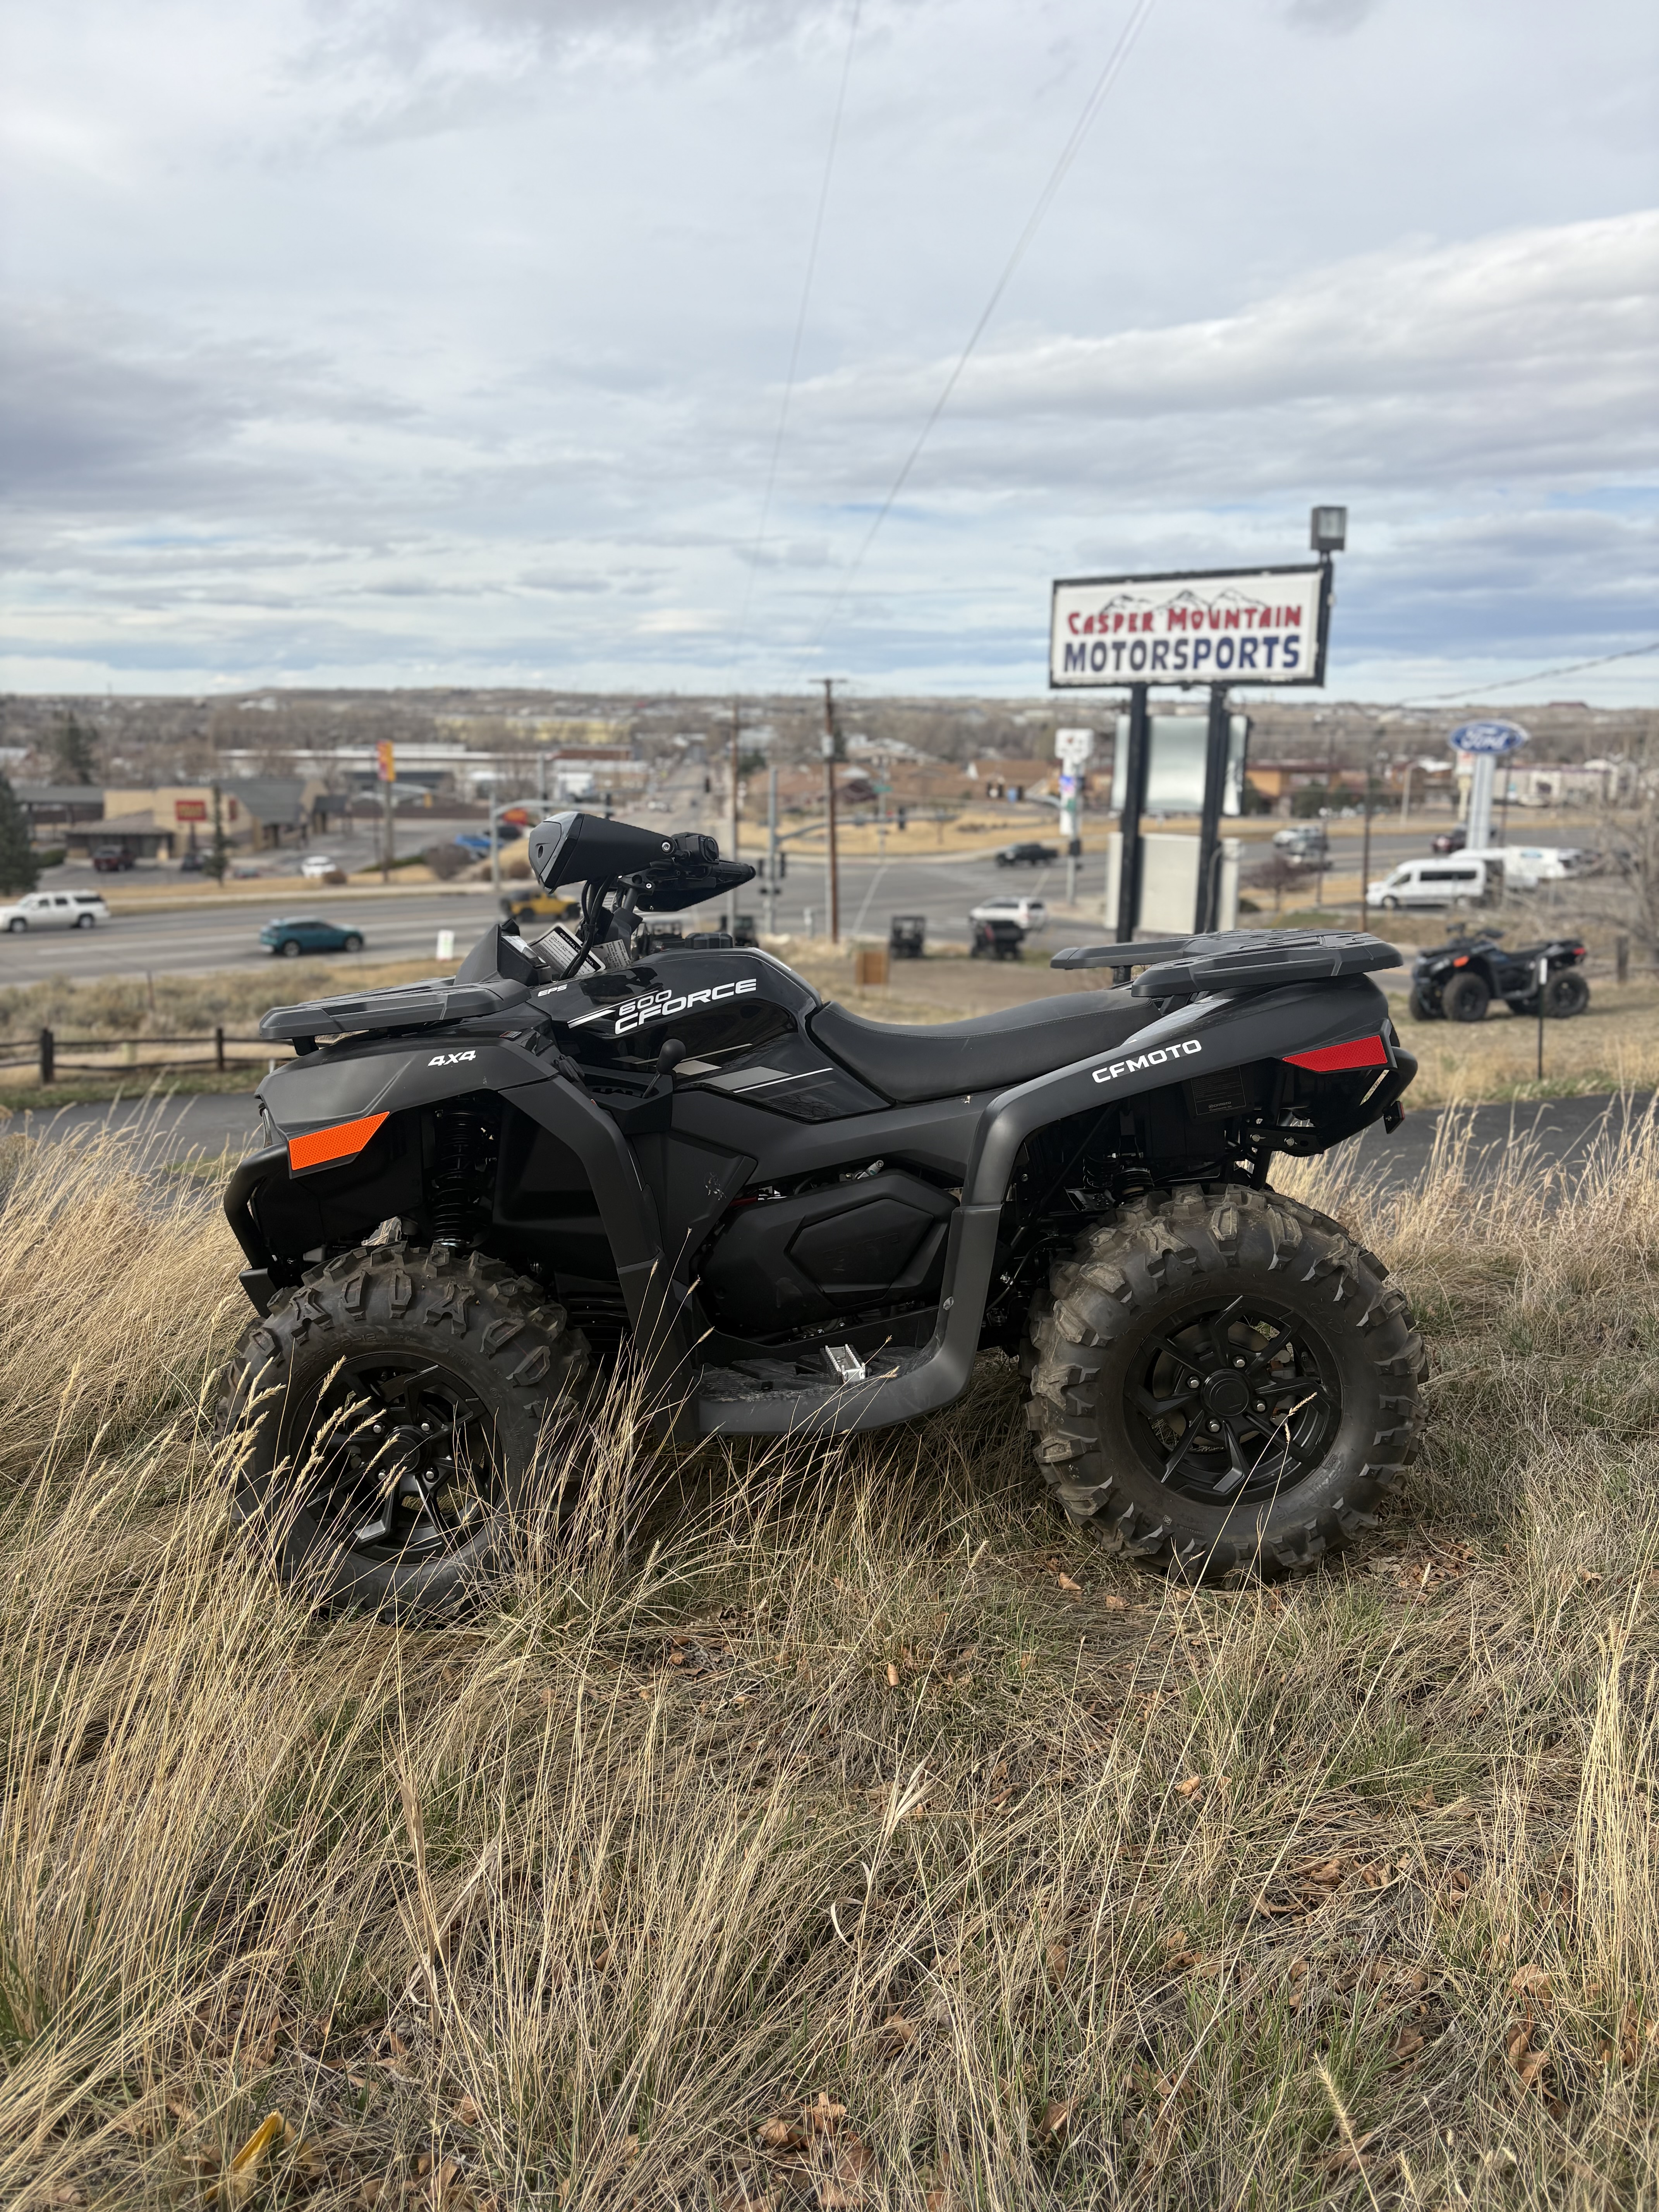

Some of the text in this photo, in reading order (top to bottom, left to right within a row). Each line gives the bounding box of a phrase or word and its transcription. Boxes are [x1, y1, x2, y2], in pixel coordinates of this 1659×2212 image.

[1068, 605, 1302, 635] CASPER MOUNTAIN
[1064, 635, 1300, 673] MOTORSPORTS
[1460, 726, 1508, 750] Ford
[560, 933, 576, 948] GENERAL
[538, 984, 568, 997] EPS
[619, 989, 672, 1016] 600
[615, 978, 757, 1035] CFORCE
[1091, 1039, 1202, 1083] CFMOTO
